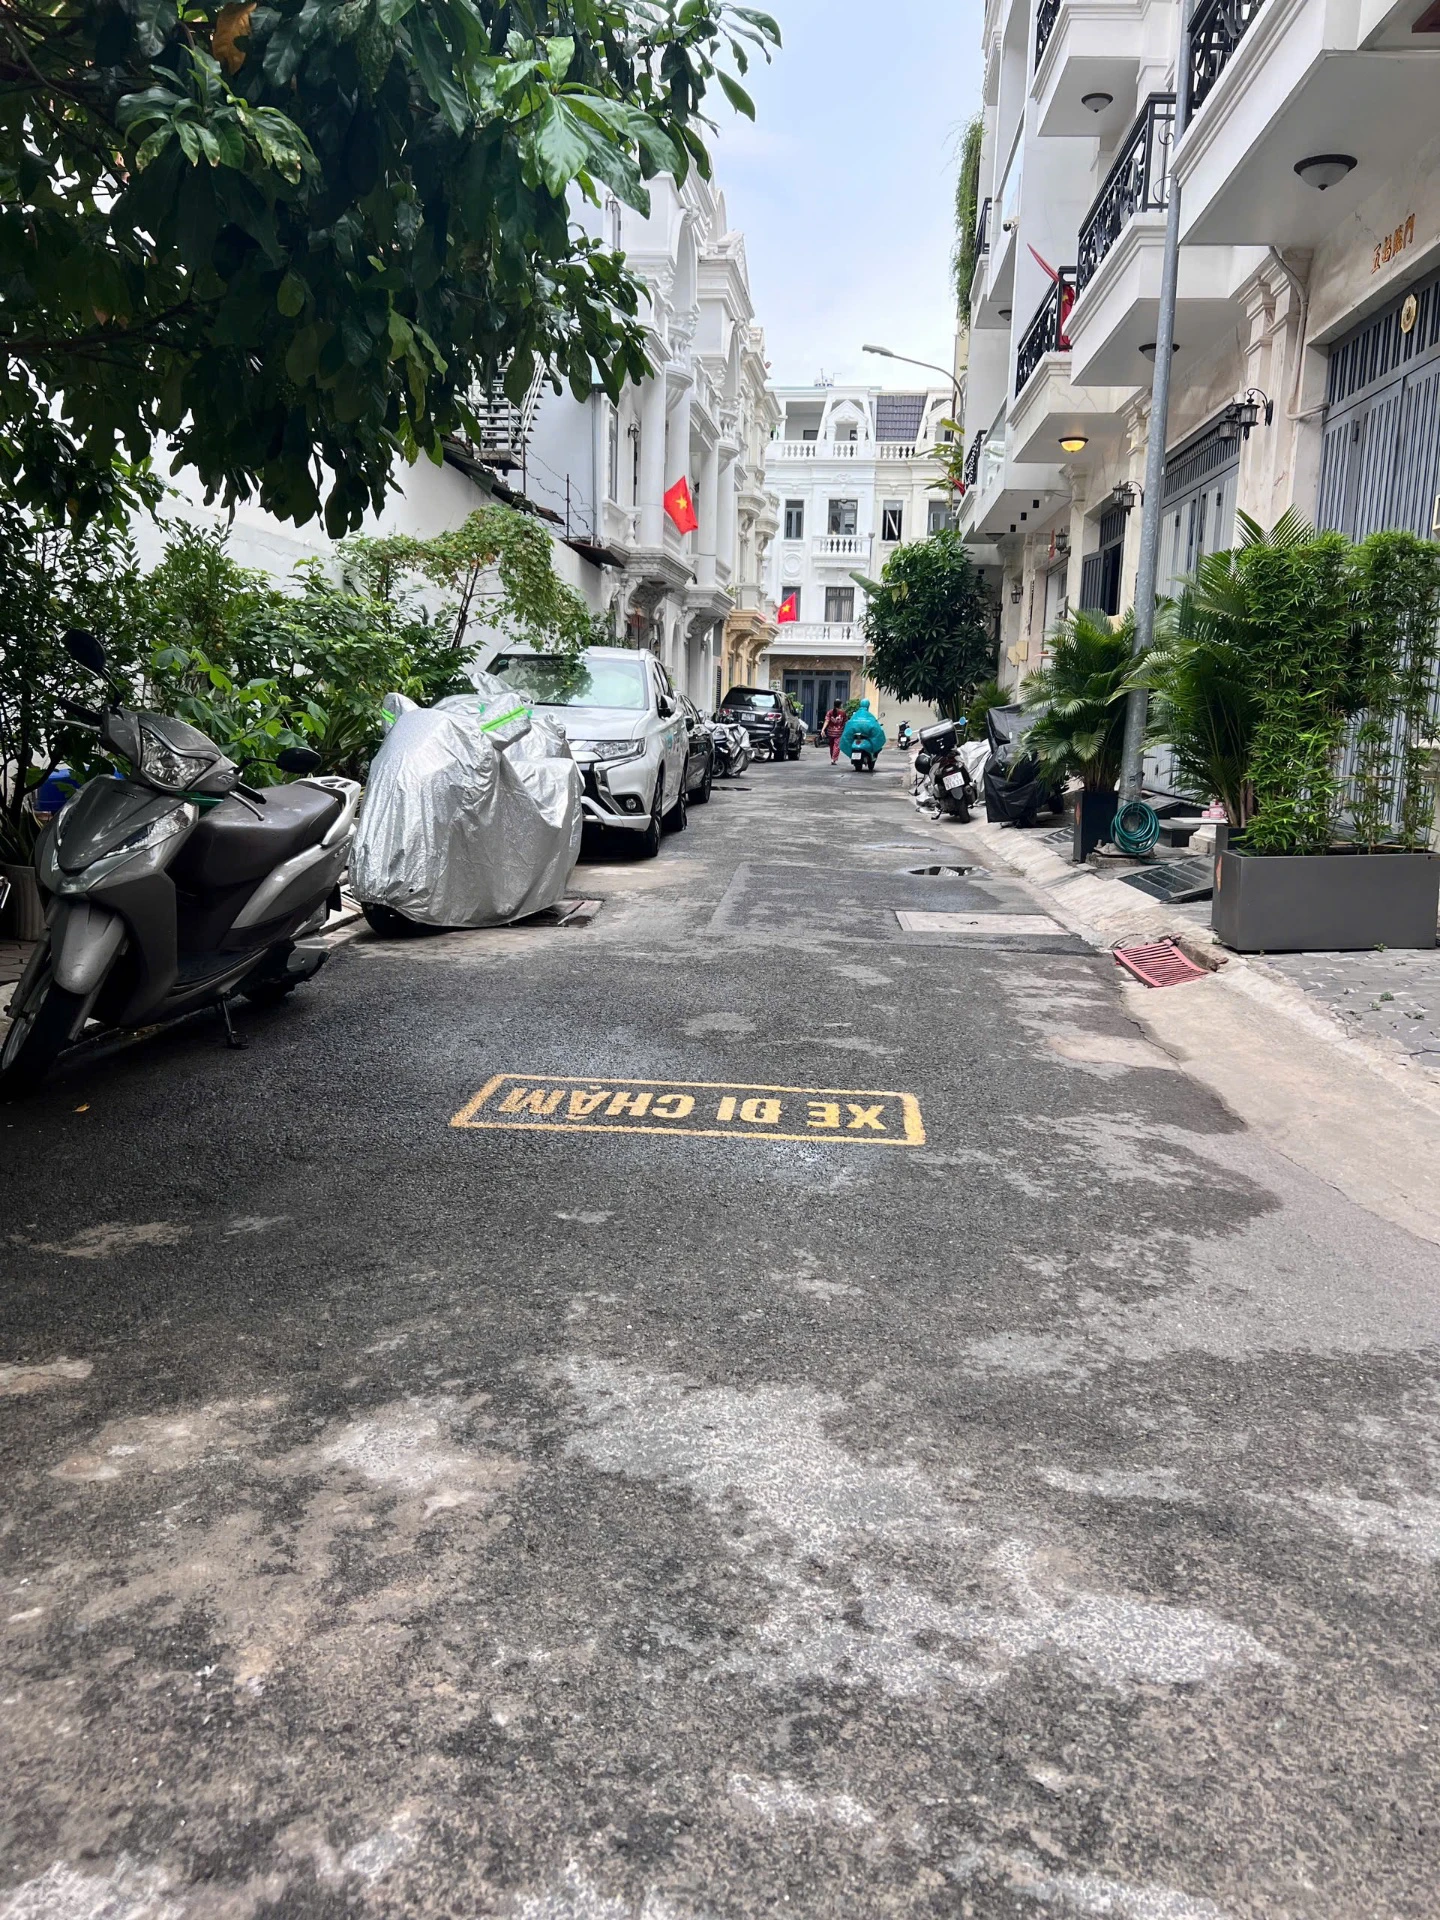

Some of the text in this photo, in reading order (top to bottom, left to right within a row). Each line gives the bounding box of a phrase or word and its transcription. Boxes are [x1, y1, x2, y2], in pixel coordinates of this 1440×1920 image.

[498, 1085, 887, 1130] XE ĐI CHẬM
